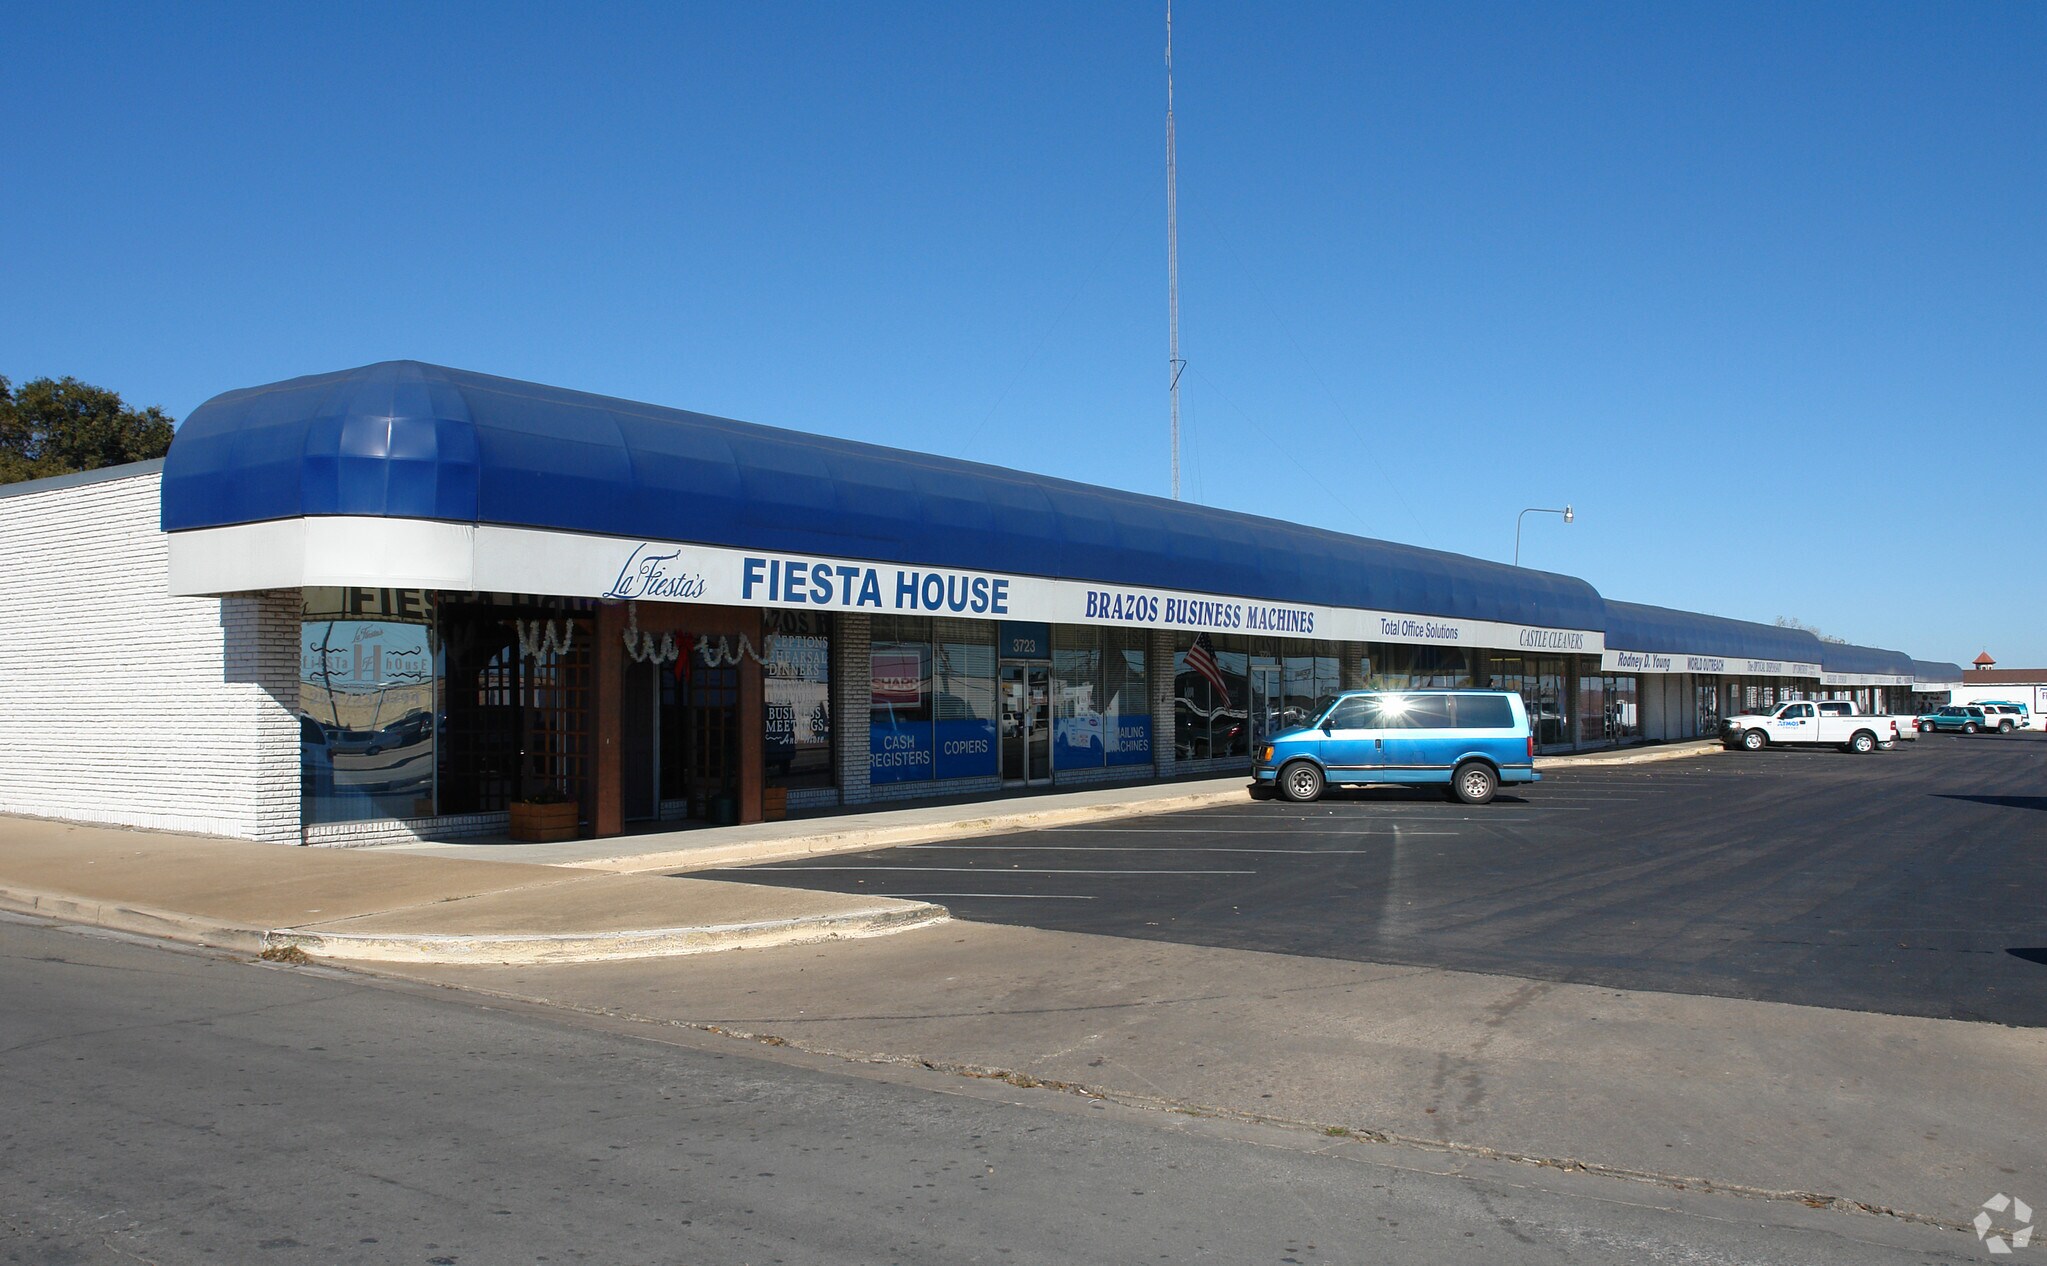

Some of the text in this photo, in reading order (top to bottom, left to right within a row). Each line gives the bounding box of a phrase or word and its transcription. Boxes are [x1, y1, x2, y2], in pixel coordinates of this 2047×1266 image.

[602, 543, 707, 599] La Fiesta's
[742, 557, 1009, 614] FIESTA HOUSE
[1085, 591, 1314, 634] BRAZOS BUSINESS MACHINES
[1381, 618, 1458, 640] Total Office Solutions
[1012, 638, 1036, 653] 3723
[1519, 629, 1584, 650] CASTLE CLEANERS
[769, 663, 820, 676] DINNERS
[1617, 652, 1671, 672] Rodney D. Young
[1687, 656, 1725, 672] WORLD OUTREACH
[884, 735, 915, 750] CASH
[944, 740, 988, 755] COPIERS
